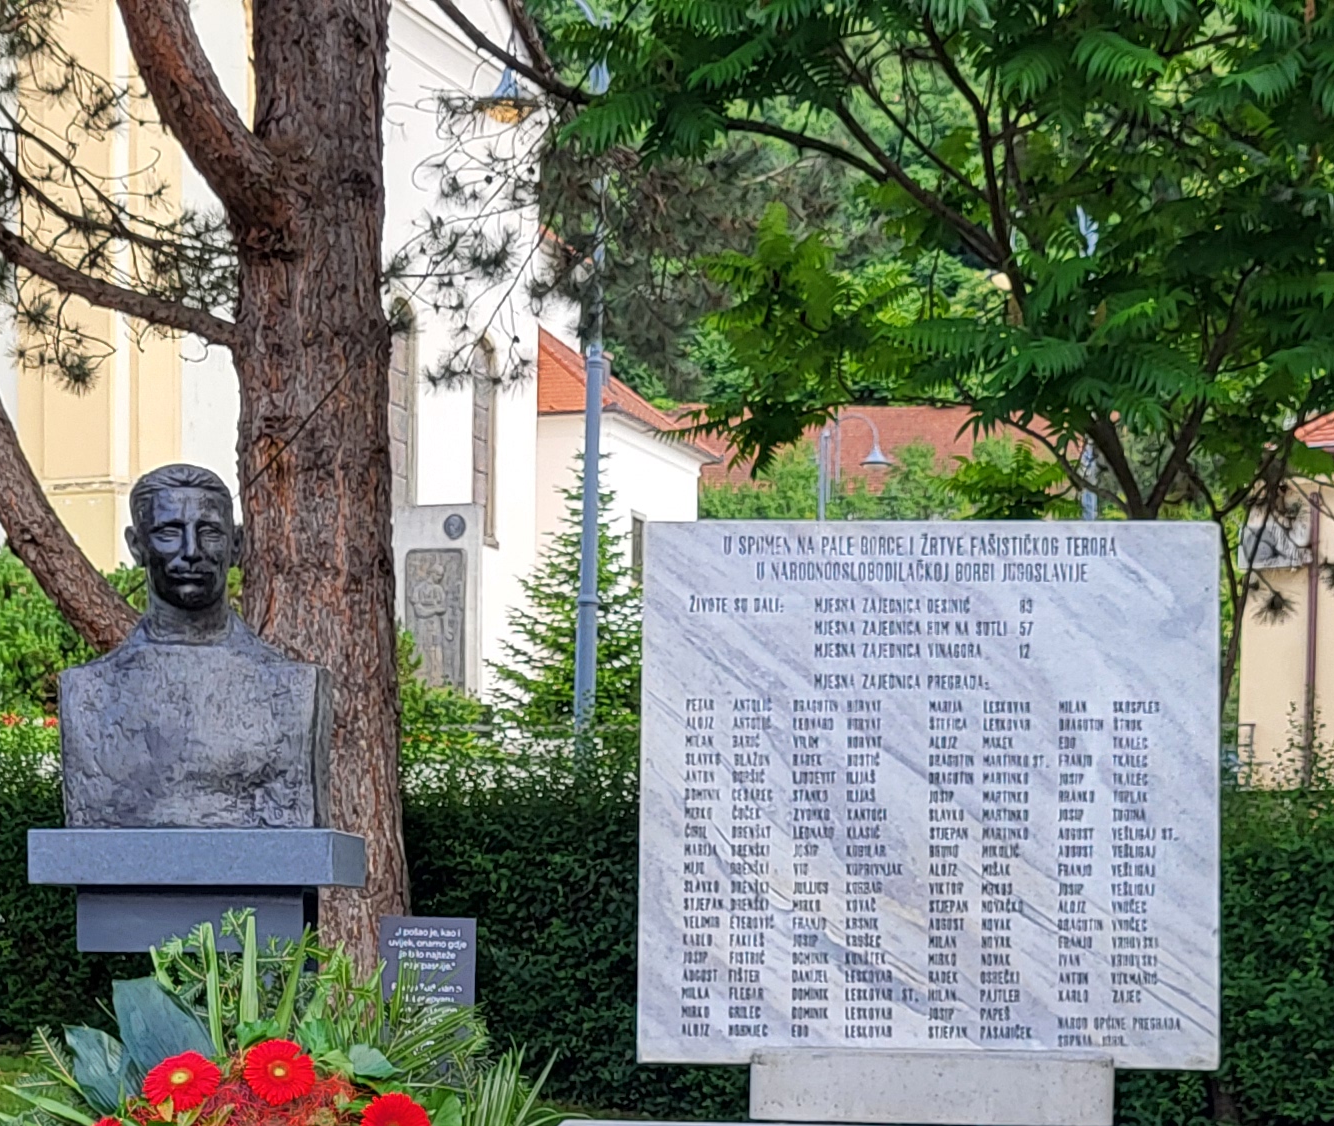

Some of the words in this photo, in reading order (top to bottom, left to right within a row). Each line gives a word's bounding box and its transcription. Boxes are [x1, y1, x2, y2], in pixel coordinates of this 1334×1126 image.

[723, 536, 732, 555] U
[797, 536, 814, 555] NA
[822, 536, 854, 556] PALE
[861, 536, 905, 556] BORCE
[921, 534, 964, 556] ŽRTVE
[970, 534, 1059, 557] FAŠISTIČKOG
[1066, 537, 1117, 557] TERORA
[756, 562, 765, 581] U
[771, 559, 949, 582] NARODNOOSLOBODILAČKOJ
[956, 563, 995, 582] BORBI
[1002, 563, 1088, 583] JUGOSLAVIJE
[690, 595, 728, 612] ŽIVOTE
[734, 598, 748, 612] SU
[754, 598, 784, 613] DALI:
[814, 598, 855, 613] MJESNA
[862, 598, 921, 613] ZAJEDNICA
[814, 621, 855, 636] MJESNA
[862, 621, 921, 636] ZAJEDNICA
[955, 622, 969, 636] NA
[1019, 622, 1033, 636] 57
[814, 644, 855, 658] MJESNA
[862, 644, 921, 658] ZAJEDNICA
[928, 644, 982, 658] VINAGORA
[1019, 645, 1030, 659] 12
[814, 674, 855, 690] MJESNA
[862, 674, 921, 690] ZAJEDNICA
